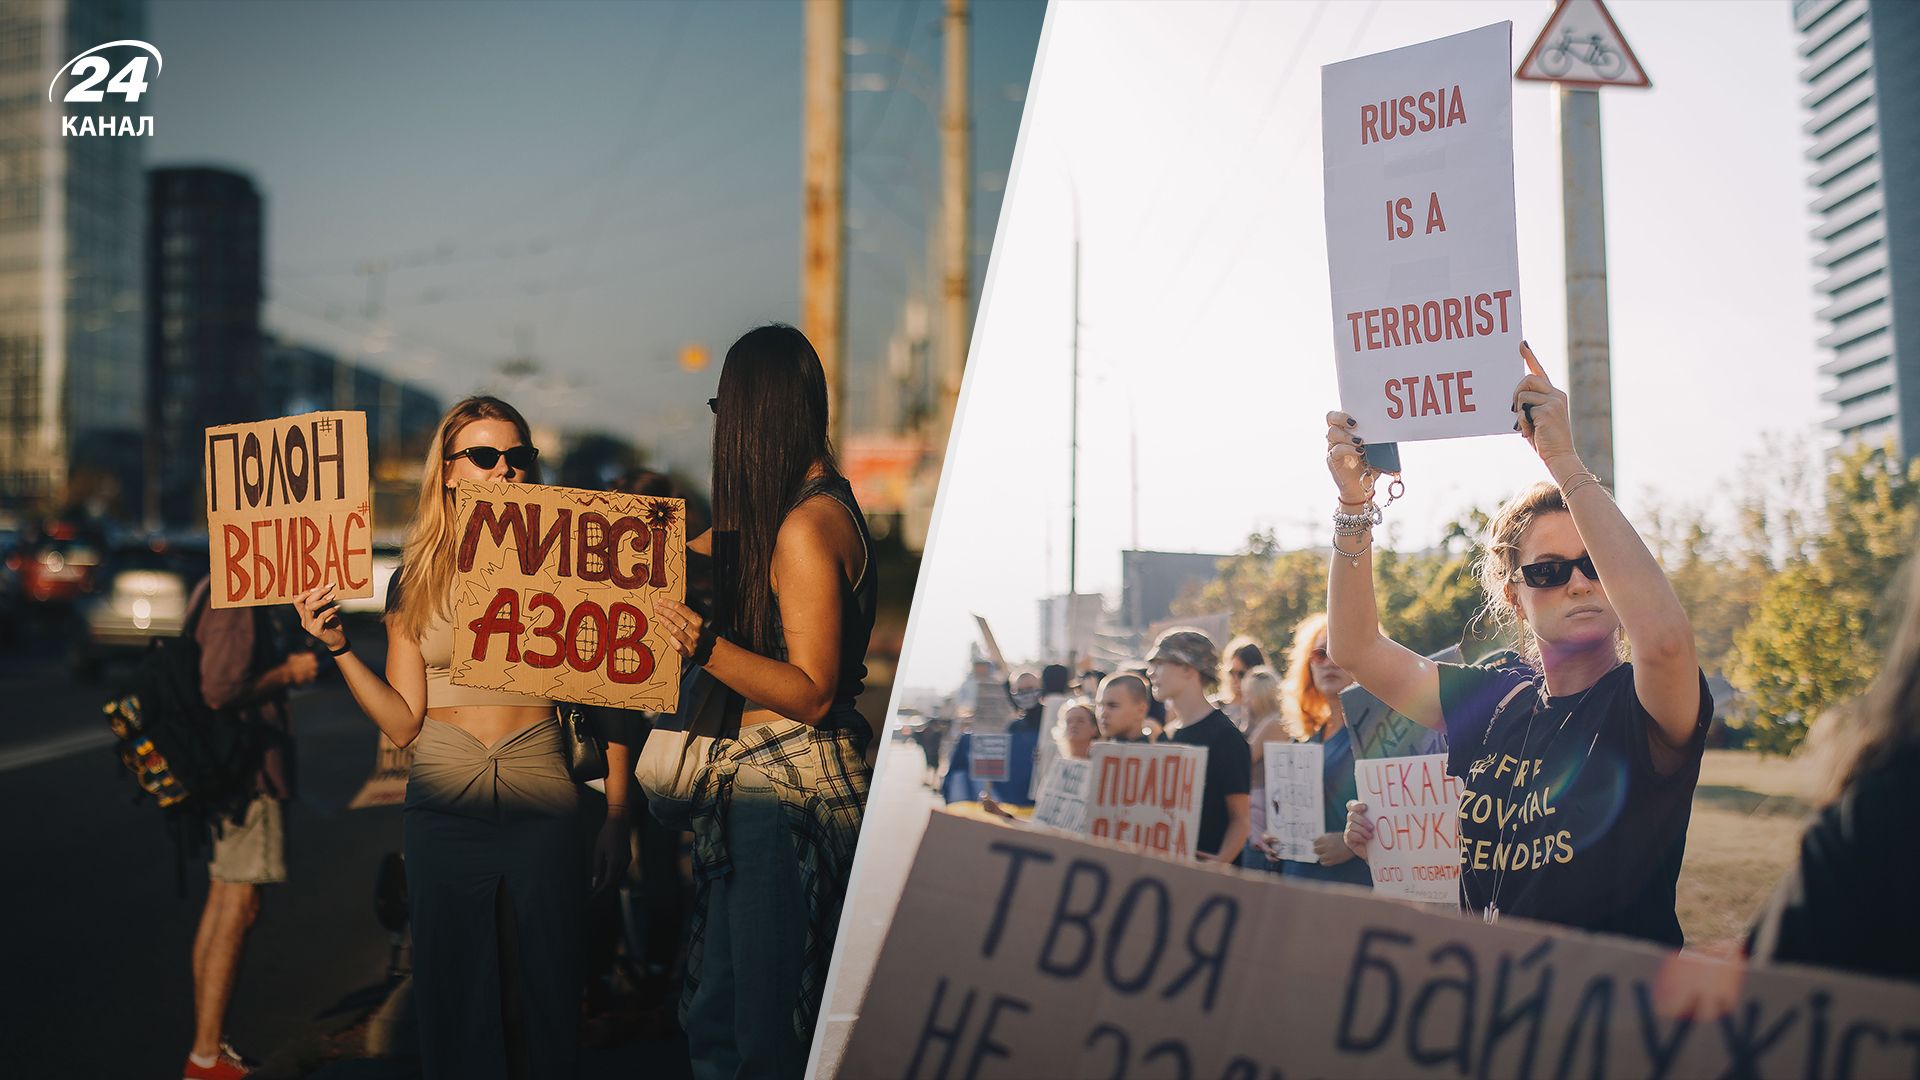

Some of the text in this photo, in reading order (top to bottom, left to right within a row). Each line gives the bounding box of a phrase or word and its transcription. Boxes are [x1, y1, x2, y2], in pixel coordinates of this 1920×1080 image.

[1360, 85, 1467, 145] RUSSIA
[1385, 191, 1447, 241] IS A
[1347, 289, 1512, 352] TERRORIST
[1384, 370, 1476, 420] STATE
[209, 419, 346, 512] ПОЛОН
[223, 511, 368, 602] ВБИВАЄ
[468, 587, 656, 684] АЗОВ
[1096, 755, 1197, 811] ПОЛОН
[1411, 863, 1460, 881] ПОБРАТИ
[980, 840, 1240, 1015] ТВОЯ
